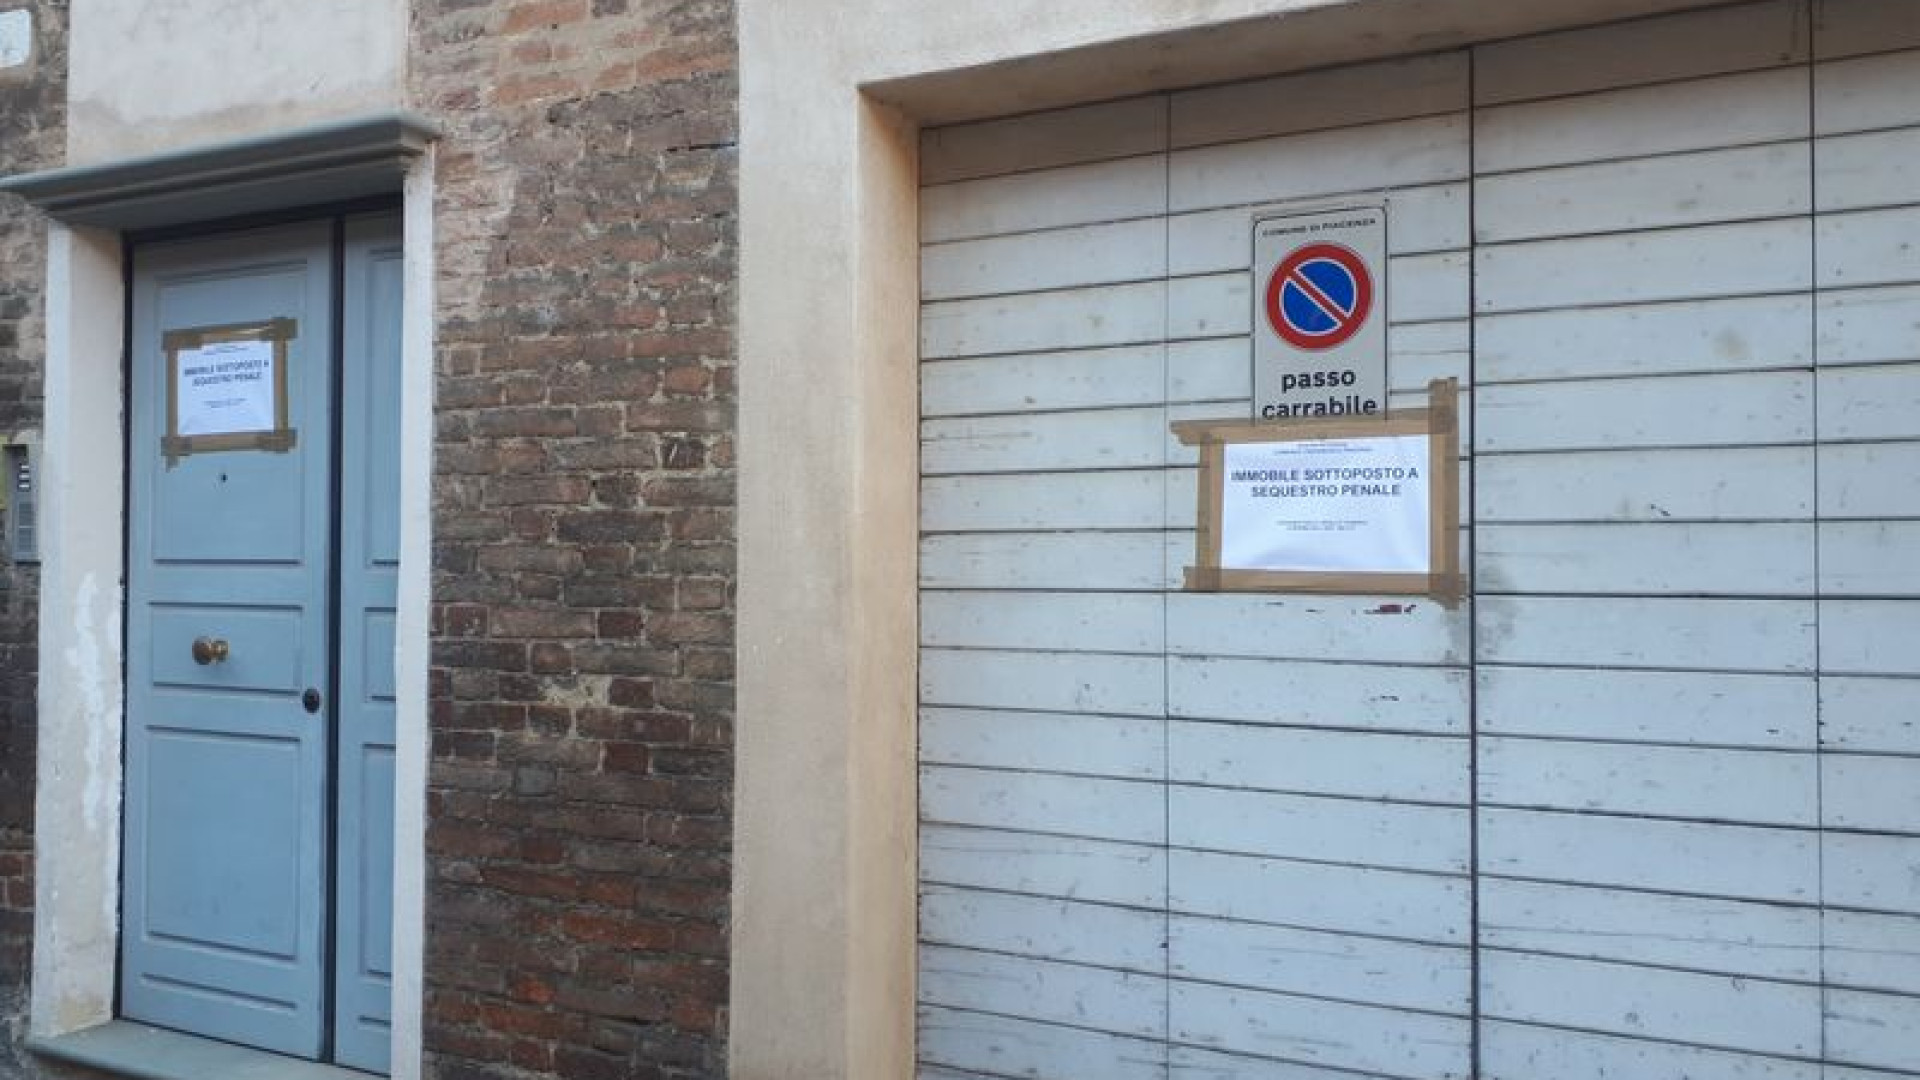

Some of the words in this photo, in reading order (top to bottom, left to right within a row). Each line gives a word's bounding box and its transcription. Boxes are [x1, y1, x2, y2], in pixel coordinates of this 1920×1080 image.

[1322, 218, 1376, 230] PIACENZA
[1281, 369, 1356, 394] passo
[1262, 395, 1377, 419] carrabile
[1231, 469, 1299, 482] IMMOBILE
[1304, 467, 1404, 481] SOTTOPOSTO
[1408, 467, 1419, 479] A
[1251, 484, 1338, 497] SEQUESTRO
[1341, 484, 1402, 496] PENALE
